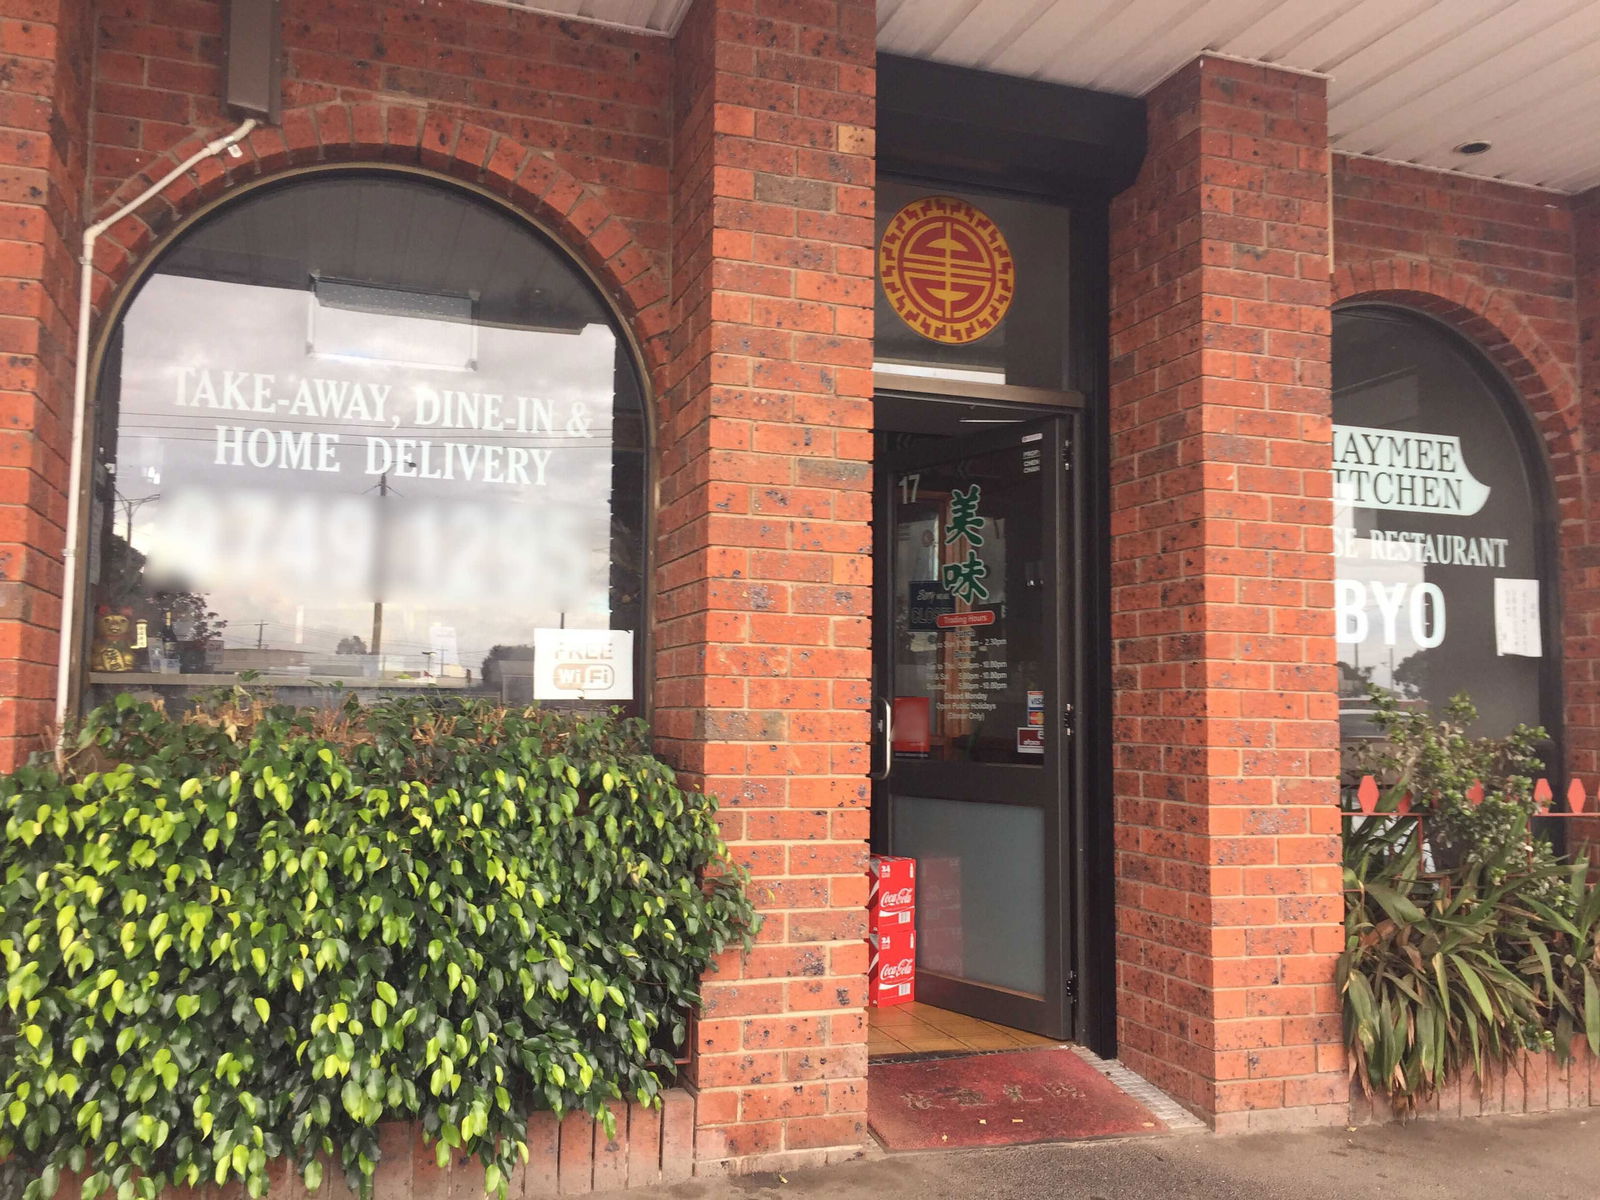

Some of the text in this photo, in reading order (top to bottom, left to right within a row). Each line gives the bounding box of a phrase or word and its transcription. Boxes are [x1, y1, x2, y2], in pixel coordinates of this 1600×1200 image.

[171, 366, 594, 438] TAKE-AWAY, DINE-IN &
[214, 425, 552, 485] HOME DELIVERY
[899, 474, 920, 504] 17
[943, 484, 989, 605] 美味
[1369, 529, 1508, 567] RESTAURANT
[1334, 579, 1446, 648] BYO
